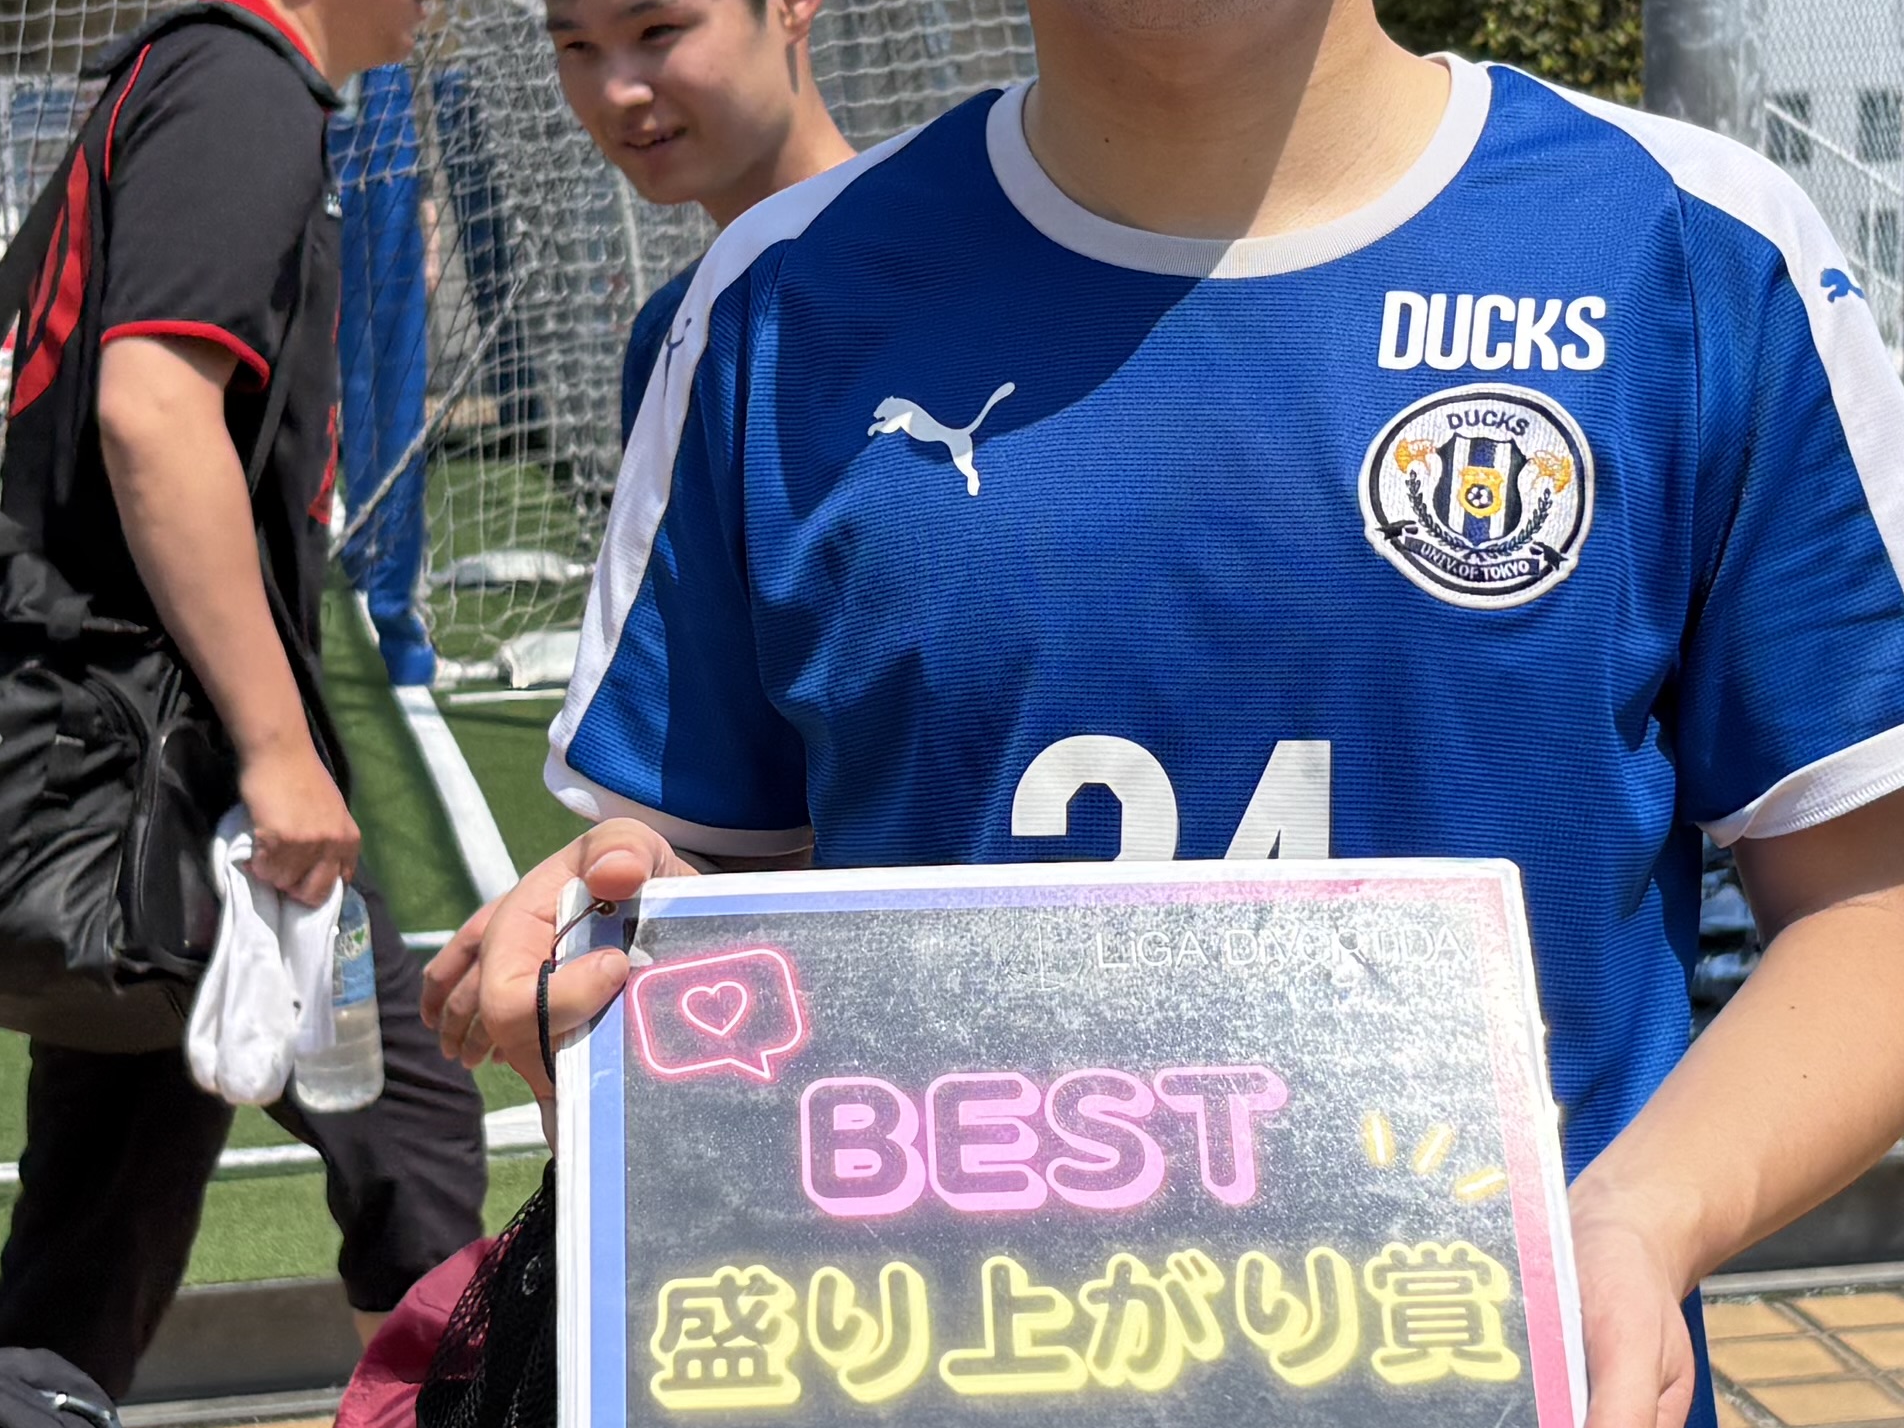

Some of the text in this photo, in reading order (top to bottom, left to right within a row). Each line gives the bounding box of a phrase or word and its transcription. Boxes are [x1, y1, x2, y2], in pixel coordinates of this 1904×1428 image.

[1377, 289, 1608, 372] DUCKS
[1446, 408, 1531, 437] DUCKS
[799, 1063, 1289, 1218] BEST
[650, 1240, 1523, 1412] 盛り上がり賞
